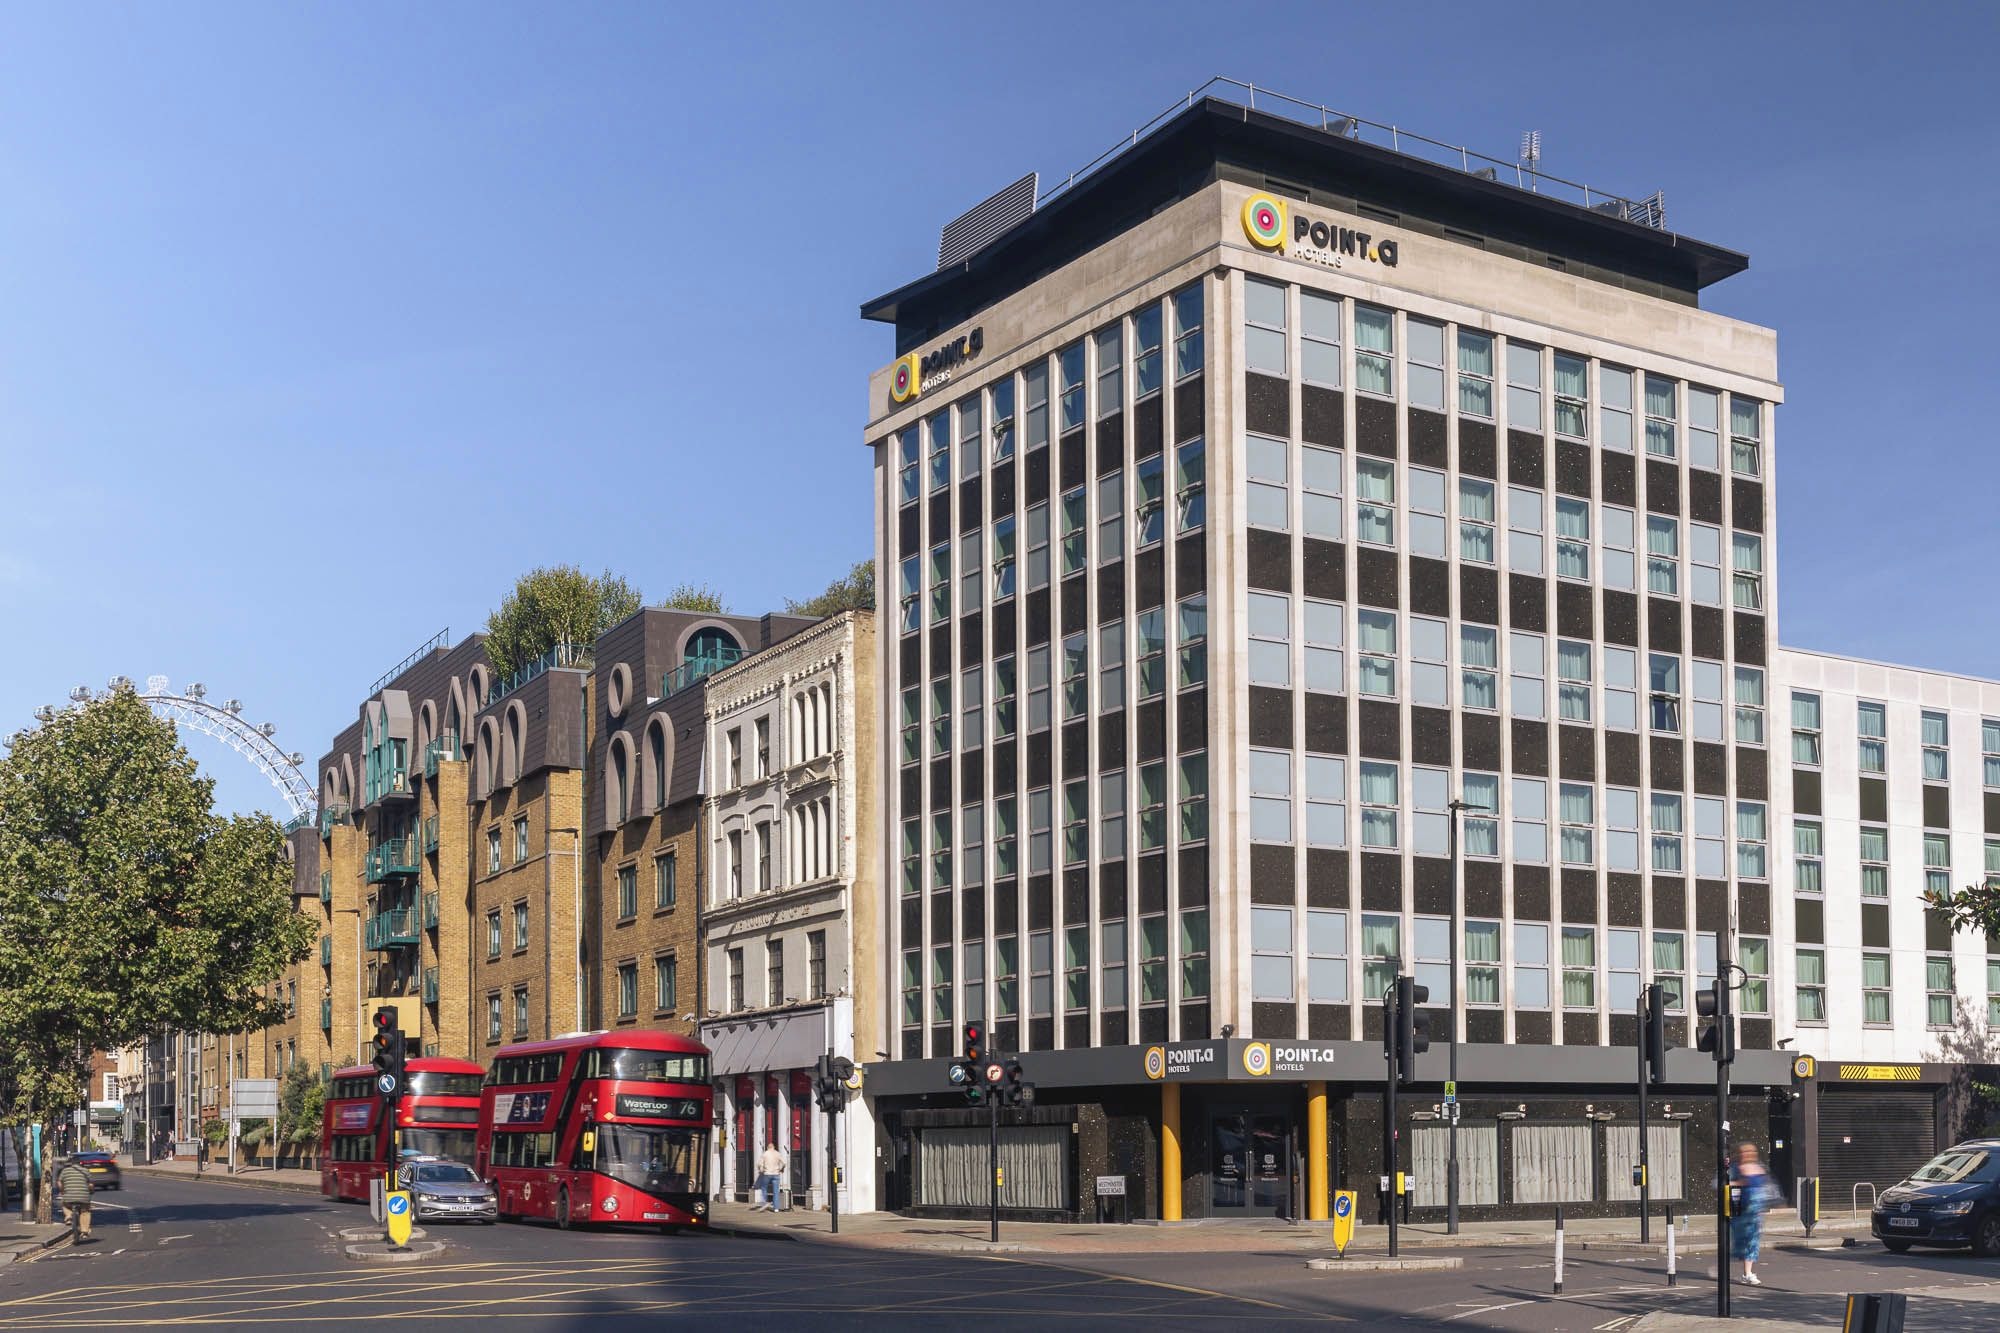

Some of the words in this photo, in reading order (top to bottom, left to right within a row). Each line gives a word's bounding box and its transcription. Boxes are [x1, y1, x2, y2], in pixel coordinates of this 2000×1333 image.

[1294, 243, 1343, 267] HOTELS
[1168, 1065, 1190, 1073] HOTELS
[680, 1101, 696, 1115] 76
